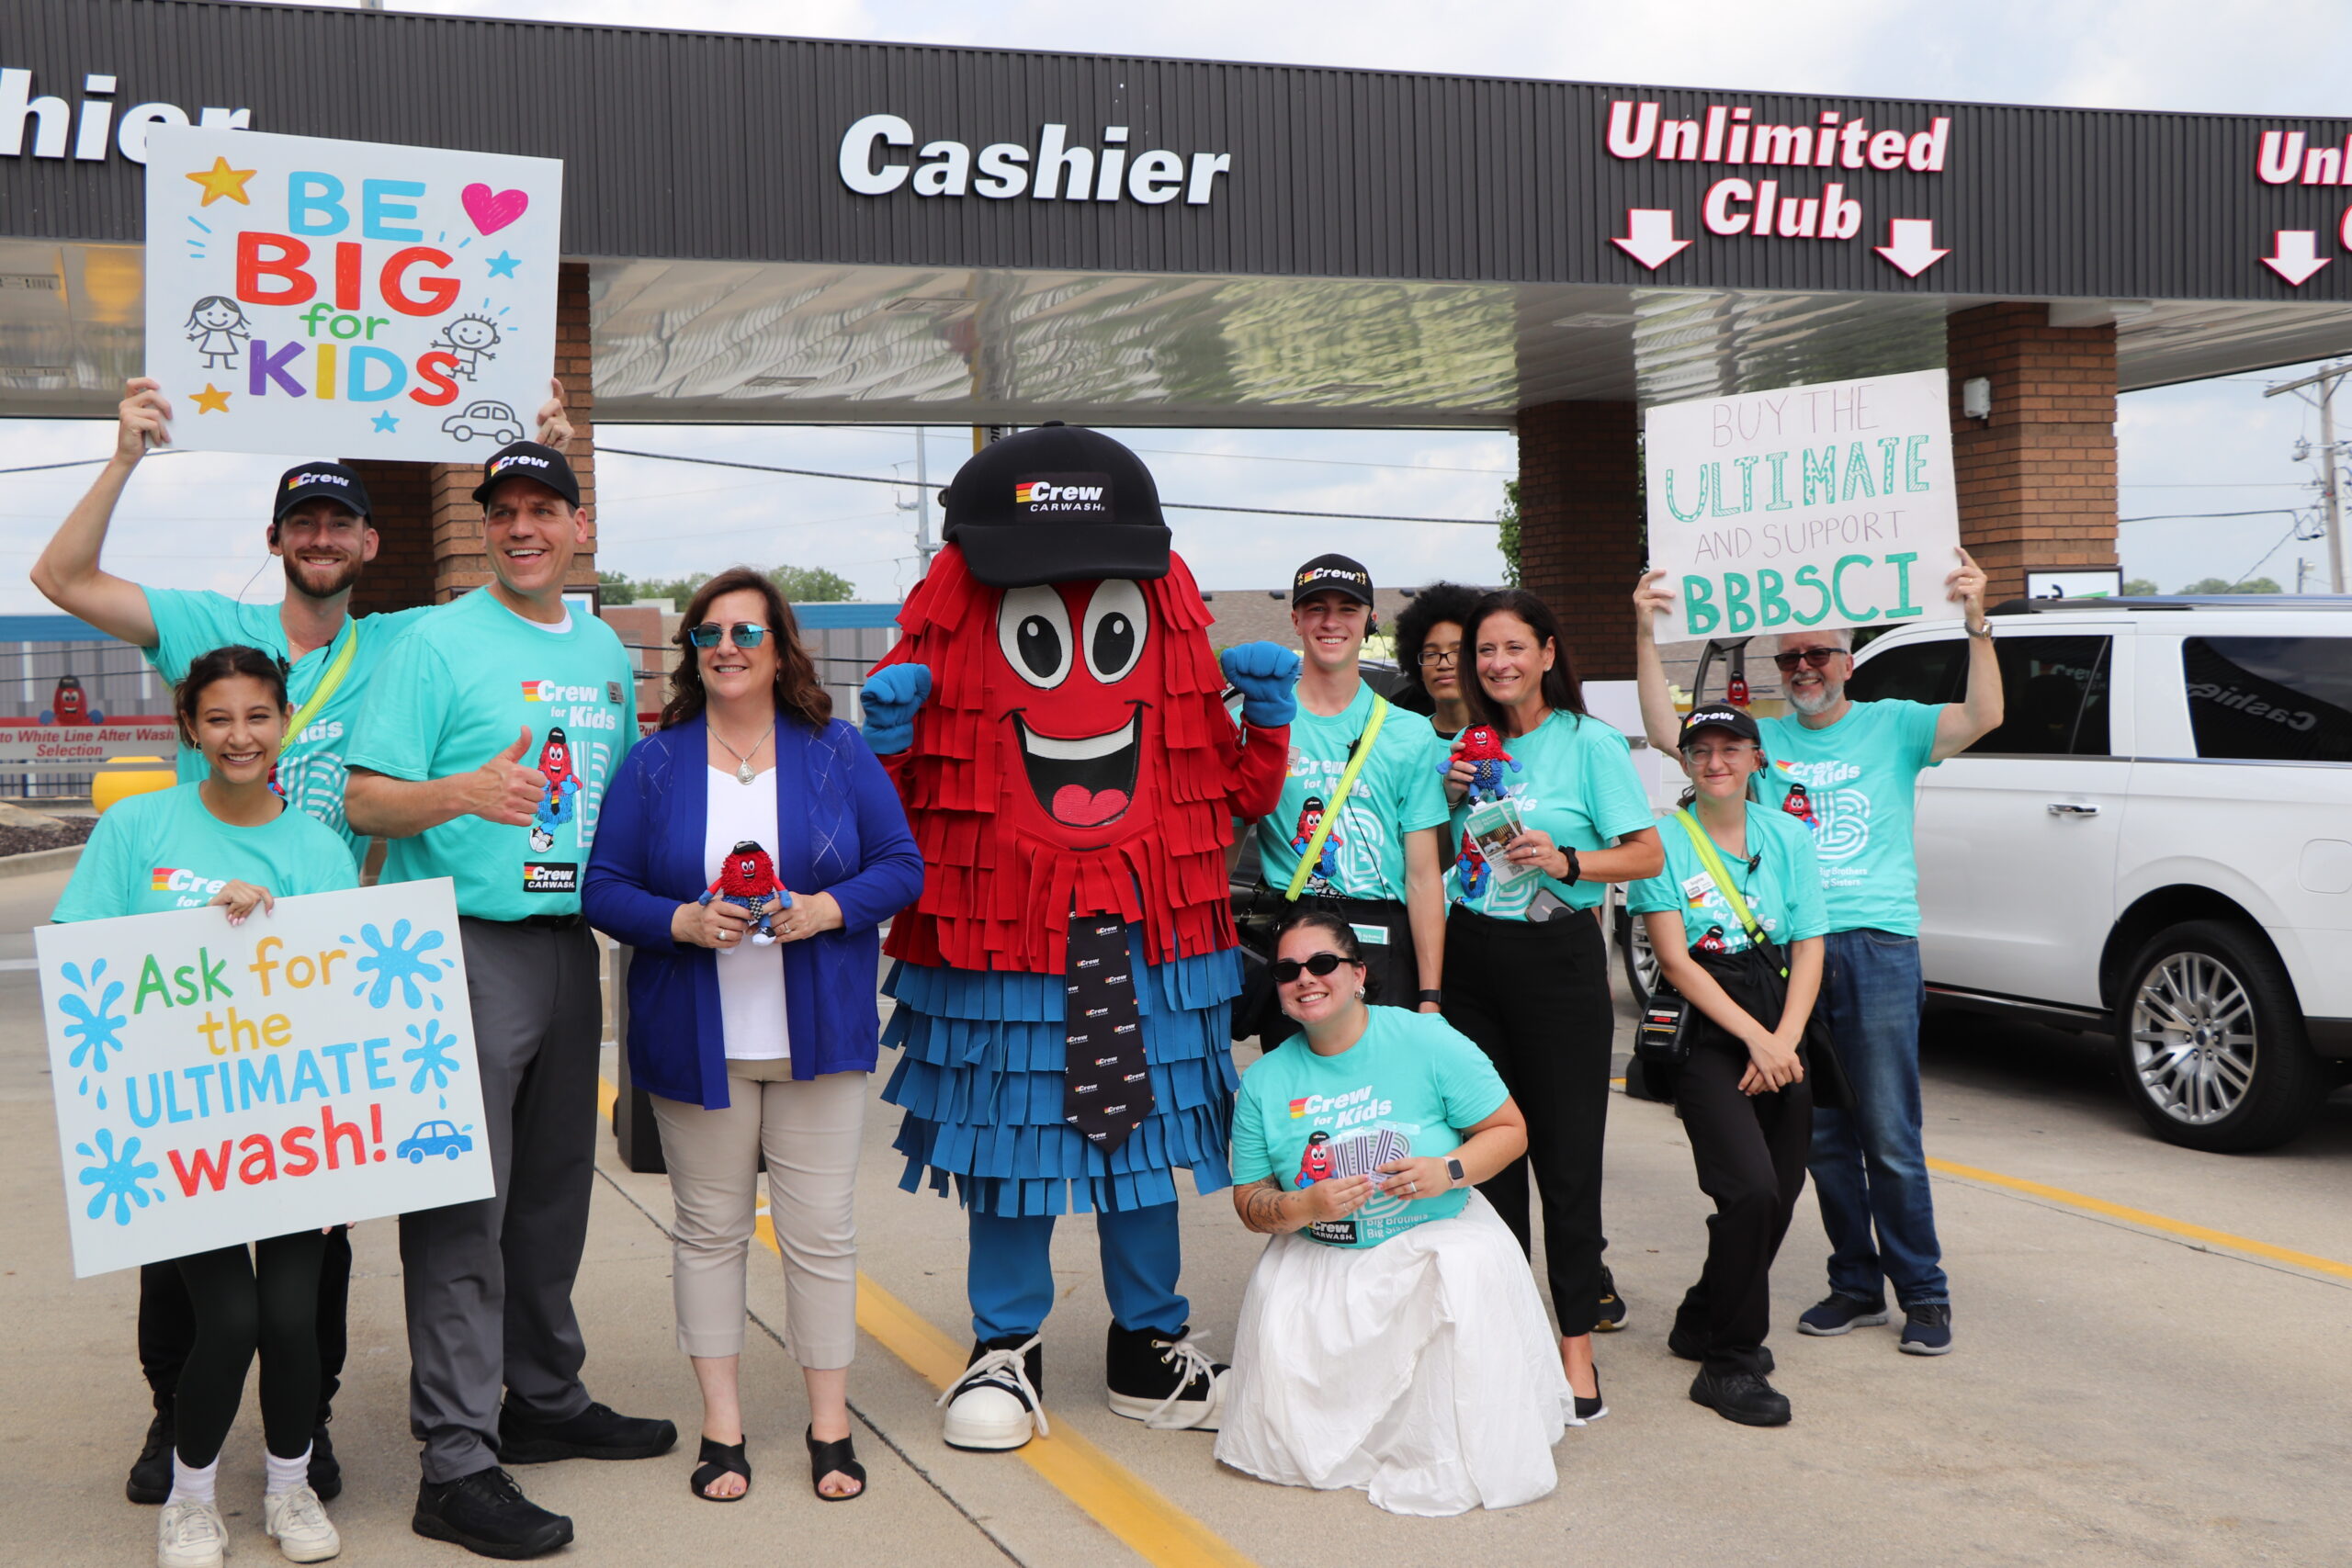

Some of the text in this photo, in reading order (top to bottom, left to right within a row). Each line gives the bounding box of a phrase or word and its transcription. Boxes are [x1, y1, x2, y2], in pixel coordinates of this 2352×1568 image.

[1607, 100, 1951, 172] Unlimited
[839, 113, 1231, 205] Cashier
[288, 171, 426, 243] BE
[1702, 177, 1862, 240] Club
[235, 231, 461, 317] BIG
[300, 302, 390, 341] for
[249, 340, 459, 406] KIDS
[1713, 384, 1879, 447] BUY THE
[498, 455, 549, 469] Crew
[297, 472, 349, 488] Crew
[1666, 434, 1929, 523] ULTIMATE
[1030, 481, 1103, 502] Crew
[1030, 503, 1102, 512] CARWASH
[1694, 510, 1907, 564] AND SUPPORT
[1313, 568, 1356, 581] Crew
[1682, 552, 1923, 635] BBBSCI
[537, 680, 598, 703] Crew
[550, 705, 616, 731] for Kids
[1694, 712, 1735, 725] Crew
[17, 730, 60, 742] White
[63, 729, 92, 742] Line
[97, 729, 131, 741] After
[136, 728, 175, 741] Wash
[296, 718, 344, 744] ids
[37, 743, 103, 757] Selection
[1811, 763, 1860, 786] Kids
[1304, 776, 1371, 798] for Kds
[168, 869, 226, 894] Cre
[532, 866, 573, 881] Crew
[1832, 867, 1868, 875] Brothers
[527, 880, 575, 889] CARWASH
[1830, 878, 1860, 886] Sisters
[176, 896, 201, 907] for
[1702, 890, 1760, 909] Crw
[1713, 909, 1729, 920] for
[1100, 925, 1118, 934] Crew
[1080, 958, 1100, 966] Crew
[133, 936, 347, 1014] Ask for
[1109, 975, 1127, 983] Crew
[1090, 1008, 1108, 1016] Crew
[198, 1006, 292, 1055] the
[1117, 1023, 1136, 1032] Crew
[125, 1037, 396, 1129] ULTIMATE
[1127, 1072, 1146, 1080] Crew
[1108, 1104, 1126, 1112] Crew
[1305, 1085, 1373, 1114] Crew
[1313, 1099, 1393, 1129] for Kids
[167, 1102, 387, 1197] wash!
[1311, 1220, 1350, 1233] Crew
[1367, 1223, 1419, 1239] Big Sist
